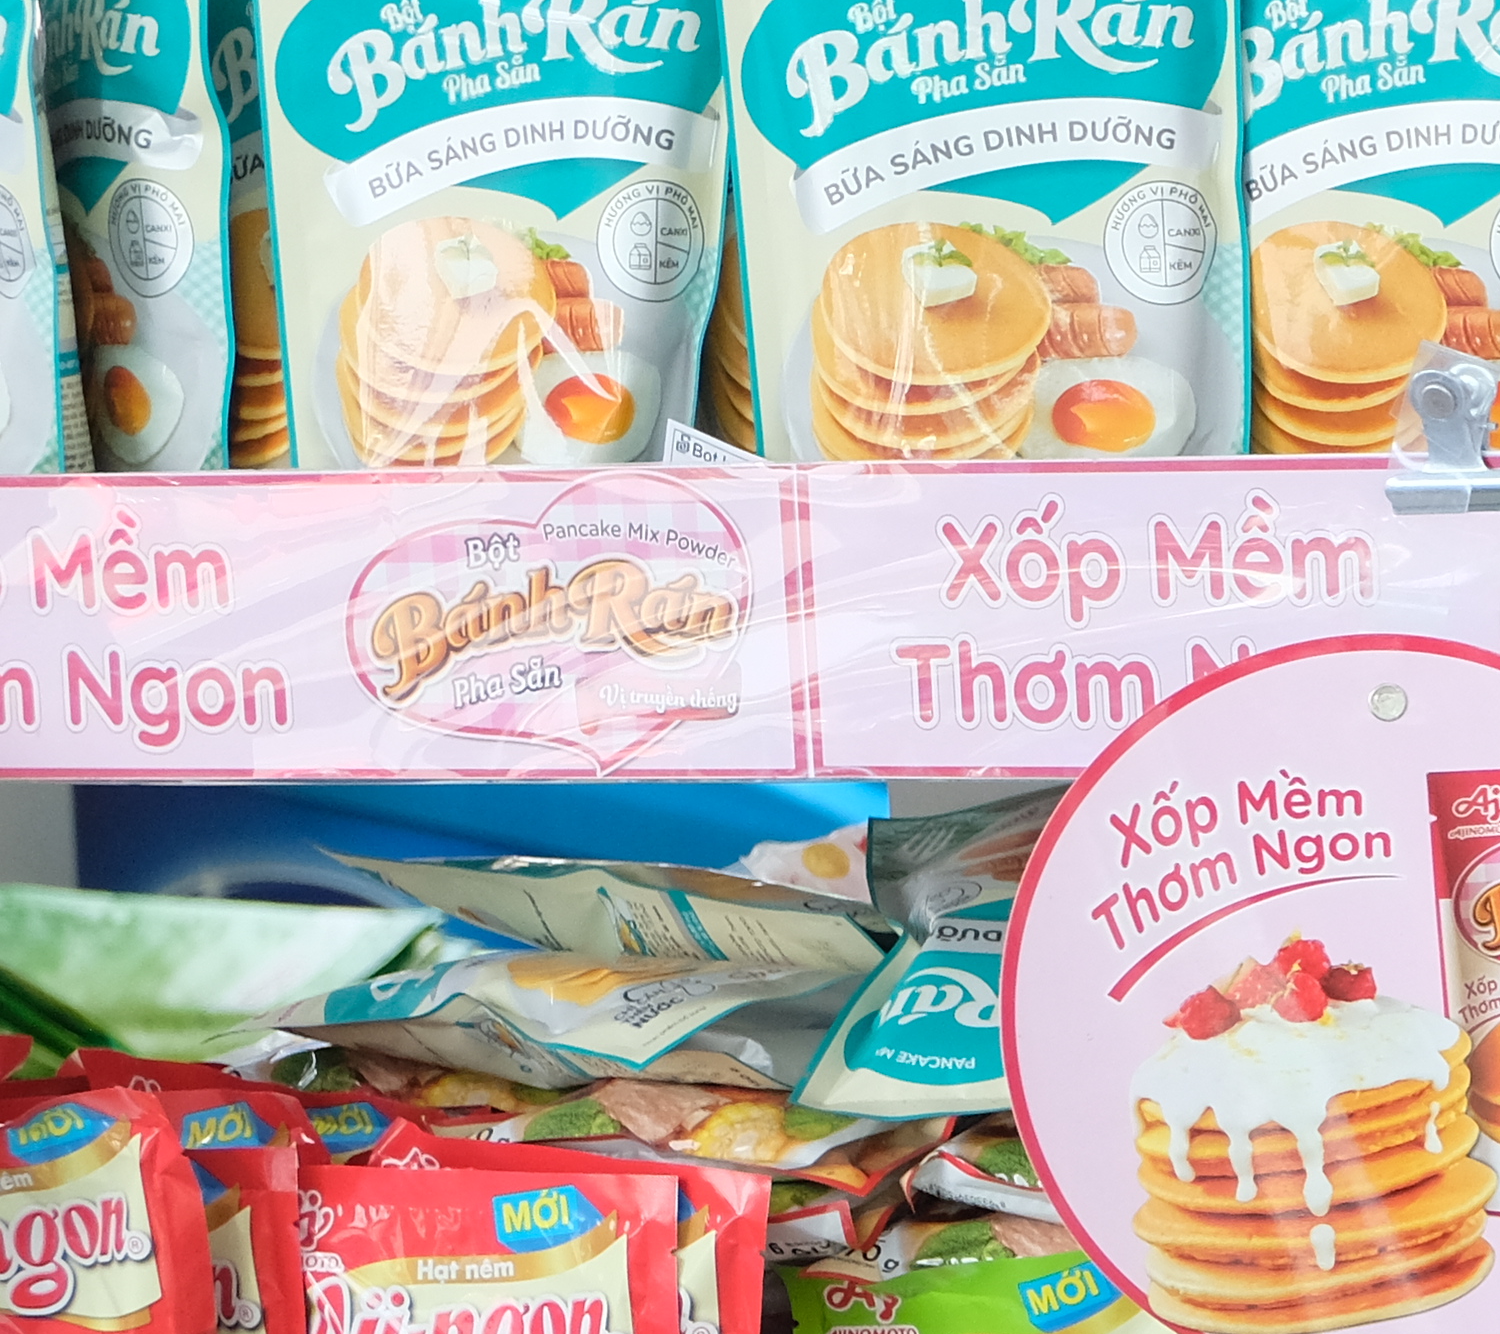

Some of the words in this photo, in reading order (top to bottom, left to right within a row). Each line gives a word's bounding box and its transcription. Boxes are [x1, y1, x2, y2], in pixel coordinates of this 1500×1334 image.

[442, 74, 491, 104] Pha
[368, 161, 423, 198] BỮA
[427, 129, 497, 171] SÁNG
[504, 120, 564, 148] DINH
[573, 114, 674, 151] DƯỠNG
[824, 165, 885, 206] BỮA
[890, 129, 975, 176] SÁNG
[983, 121, 1057, 151] DINH
[1068, 116, 1176, 150] DƯỠNG
[1245, 161, 1298, 202] BỮA
[1302, 134, 1378, 174] SÁNG
[1385, 125, 1452, 152] DINH
[29, 507, 230, 610] Mềm
[465, 534, 520, 569] Bột
[543, 519, 622, 541] Pancake
[627, 522, 660, 543] Mix
[665, 532, 738, 567] Powder
[941, 498, 1120, 624] Xốp
[1152, 494, 1374, 602] Mềm
[64, 650, 288, 747] Ngon
[453, 673, 503, 709] Pha
[511, 657, 562, 691] Sẵn
[895, 640, 1156, 725] Thơm
[1109, 780, 1219, 869] Xốp
[1237, 769, 1363, 825] Mềm
[1091, 850, 1237, 950] Thơm
[1252, 829, 1391, 876] Ngon
[502, 1190, 570, 1233] MỚI
[417, 1260, 459, 1284] Hạt
[465, 1259, 514, 1279] nêm
[1026, 1265, 1101, 1317] MỚI
